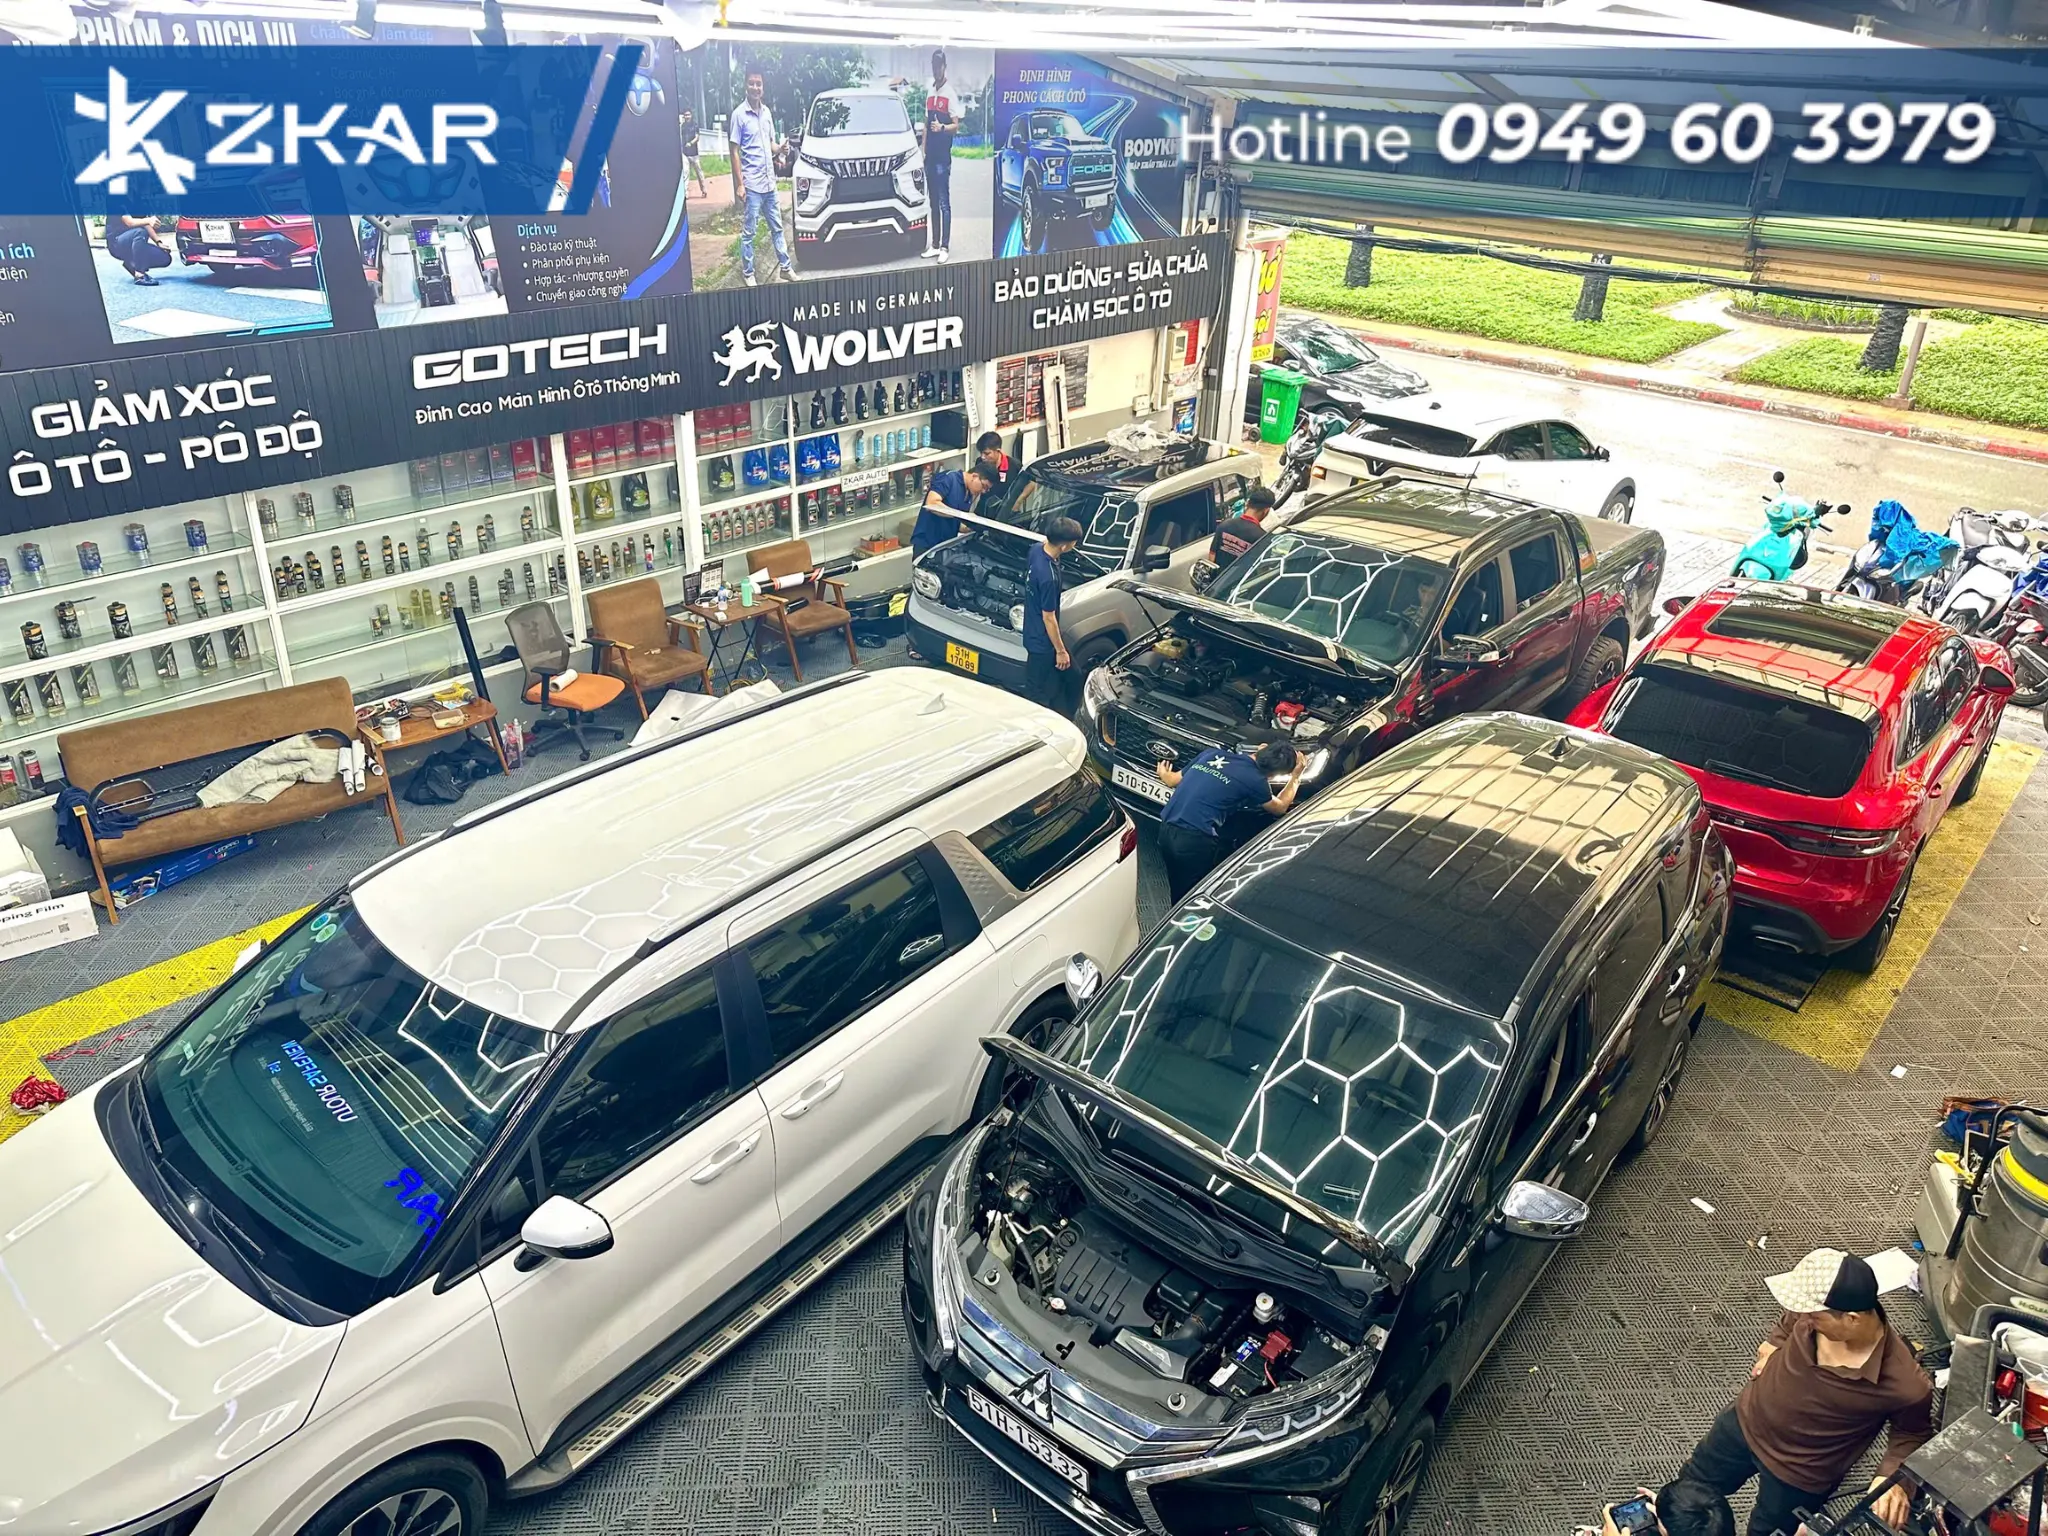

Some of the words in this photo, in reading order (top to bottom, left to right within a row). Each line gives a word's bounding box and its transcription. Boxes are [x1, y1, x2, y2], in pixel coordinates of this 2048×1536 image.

[1019, 69, 1045, 85] ĐỊNH
[1002, 90, 1038, 104] PHONG
[1040, 88, 1065, 103] CÁCH
[1073, 163, 1113, 175] FORD
[518, 223, 541, 239] Dịch
[543, 224, 557, 237] vụ
[9, 243, 35, 260] ích
[530, 242, 547, 253] Đào
[549, 242, 563, 253] tạo
[575, 237, 597, 249] thuật
[532, 256, 554, 269] Phân
[555, 254, 573, 269] phối
[576, 254, 591, 267] phụ
[593, 253, 610, 266] kiện
[534, 276, 551, 287] Hợp
[553, 273, 566, 283] tác
[572, 270, 604, 282] nhượng
[605, 267, 629, 281] quyền
[994, 268, 1038, 302] BẢO
[1044, 261, 1111, 295] DƯỠNG
[1127, 251, 1163, 283] SỬA
[1166, 246, 1208, 276] CHỮA
[536, 288, 567, 303] Chuyển
[569, 288, 586, 302] giao
[587, 285, 607, 298] công
[608, 283, 628, 297] nghệ
[793, 302, 841, 322] MADE
[850, 299, 866, 315] IN
[876, 287, 954, 311] GERMANY
[1032, 299, 1089, 330] CHĂM
[1093, 288, 1129, 320] SÓC
[413, 323, 667, 389] GOTECH
[781, 316, 963, 375] WOLVER
[31, 379, 171, 438] GIẢM
[173, 367, 276, 417] XÓC
[415, 404, 453, 425] Đỉnh
[457, 400, 492, 417] Cao
[603, 375, 649, 395] Thông
[651, 371, 680, 387] Minh
[180, 420, 249, 470] PÔ
[255, 409, 323, 459] ĐỘ
[843, 474, 865, 485] ZKAR
[865, 469, 887, 480] AUTO
[955, 646, 970, 660] 51H
[1117, 770, 1172, 803] 51D-674.9
[0, 911, 33, 925] ping
[35, 903, 65, 914] Film
[971, 1391, 1084, 1488] 51H-153.32
